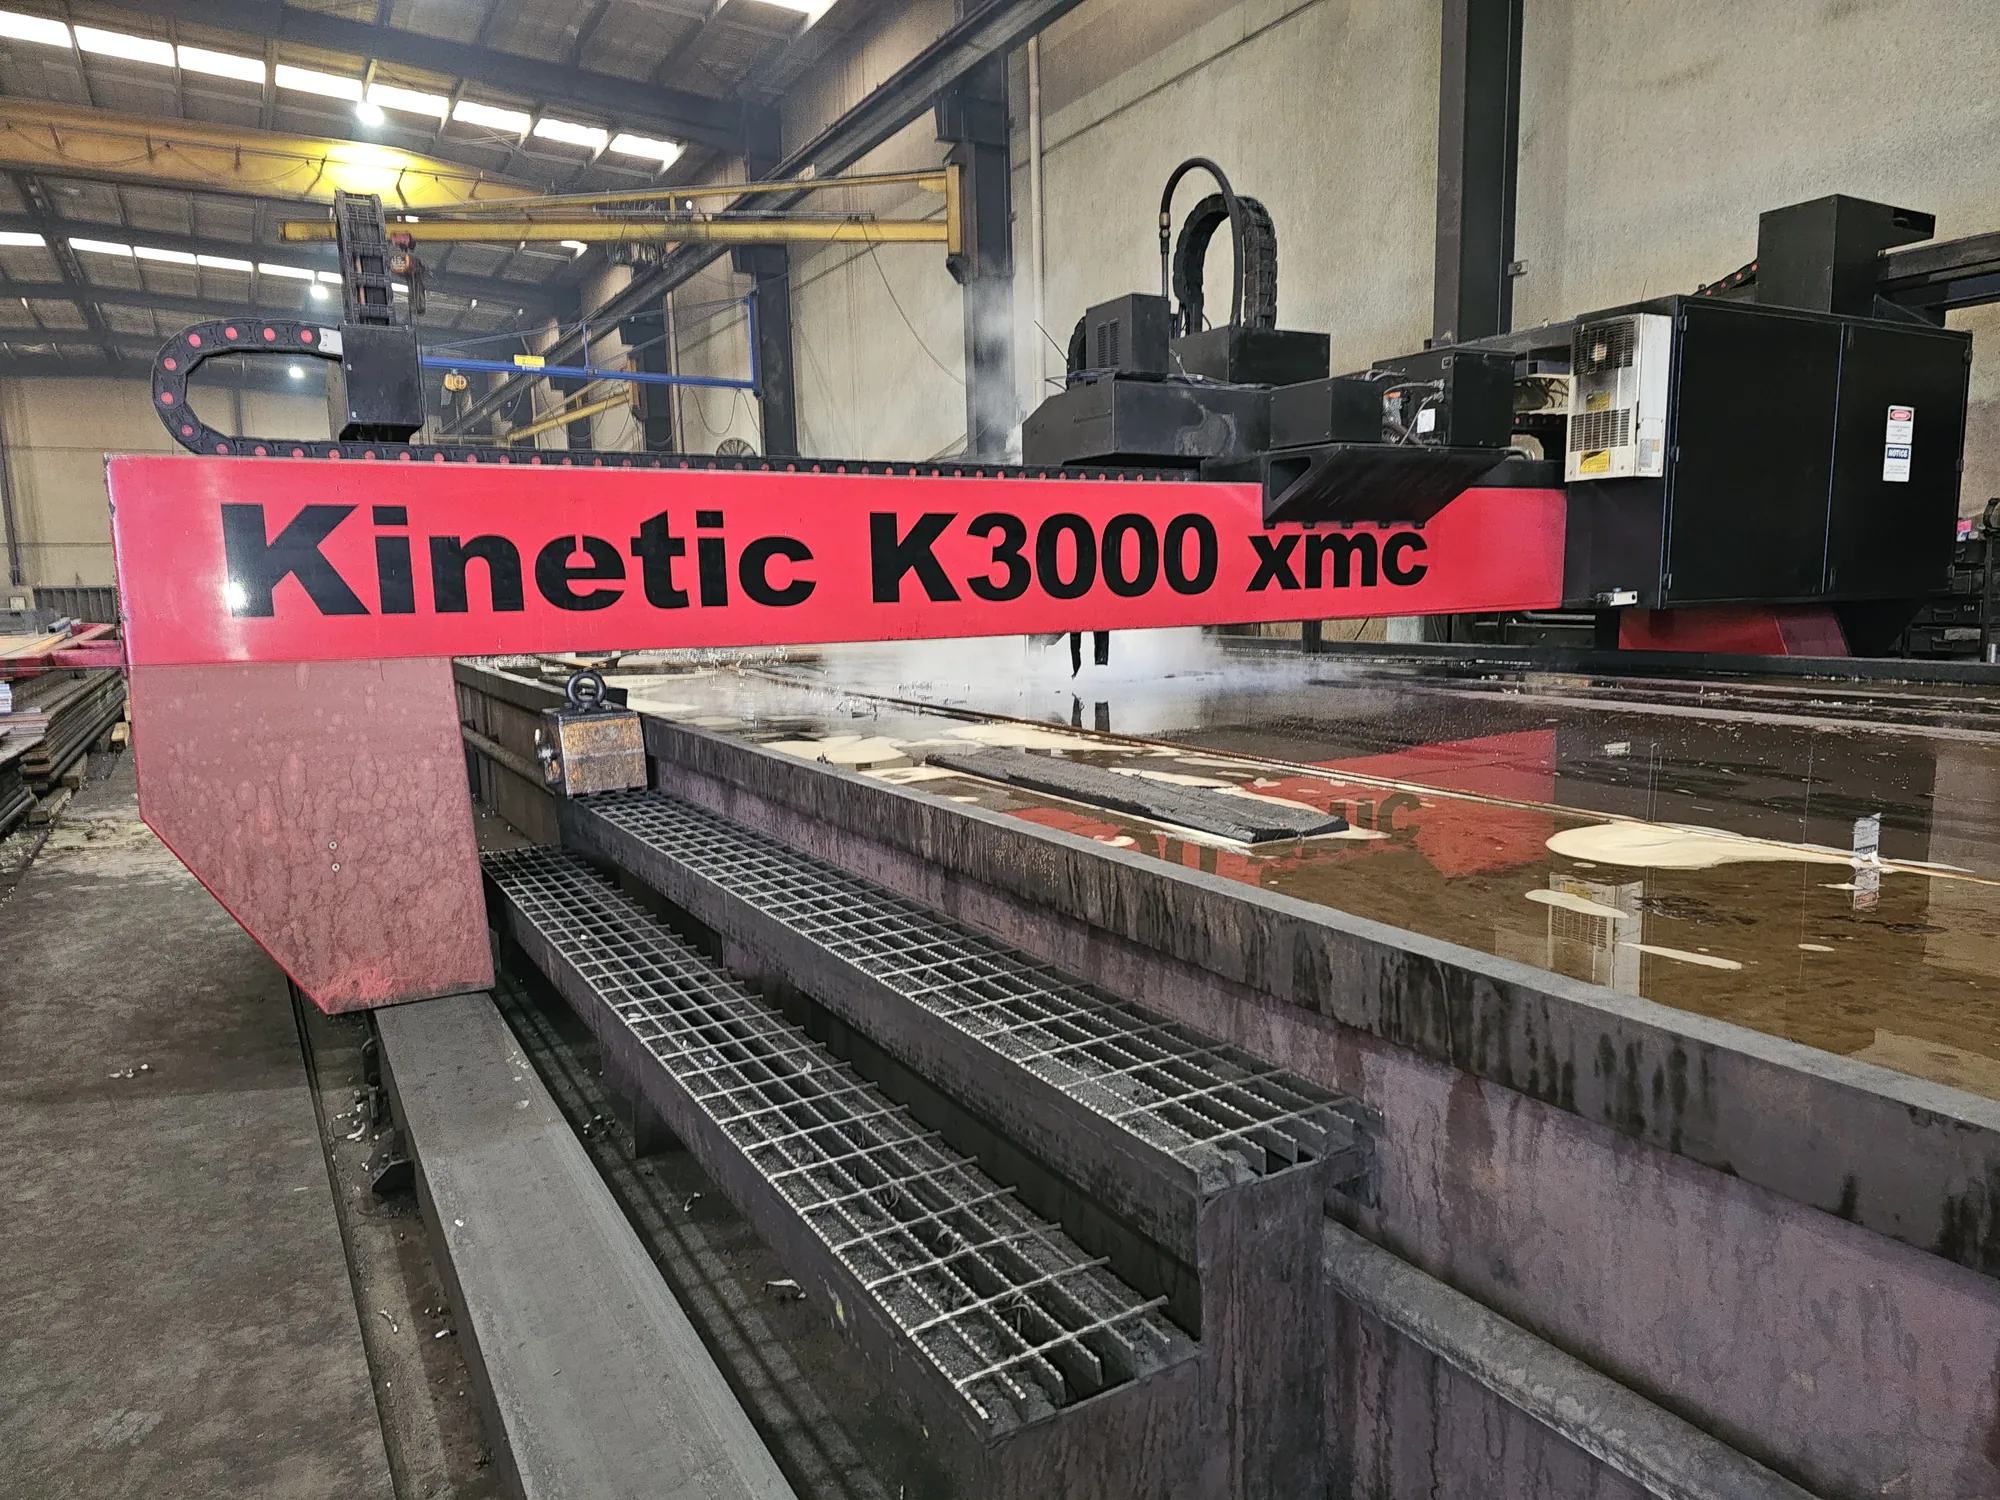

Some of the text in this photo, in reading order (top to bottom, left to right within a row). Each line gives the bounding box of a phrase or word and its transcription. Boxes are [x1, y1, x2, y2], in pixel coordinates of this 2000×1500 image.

[221, 503, 1428, 617] Kinetic K3000 xmc
